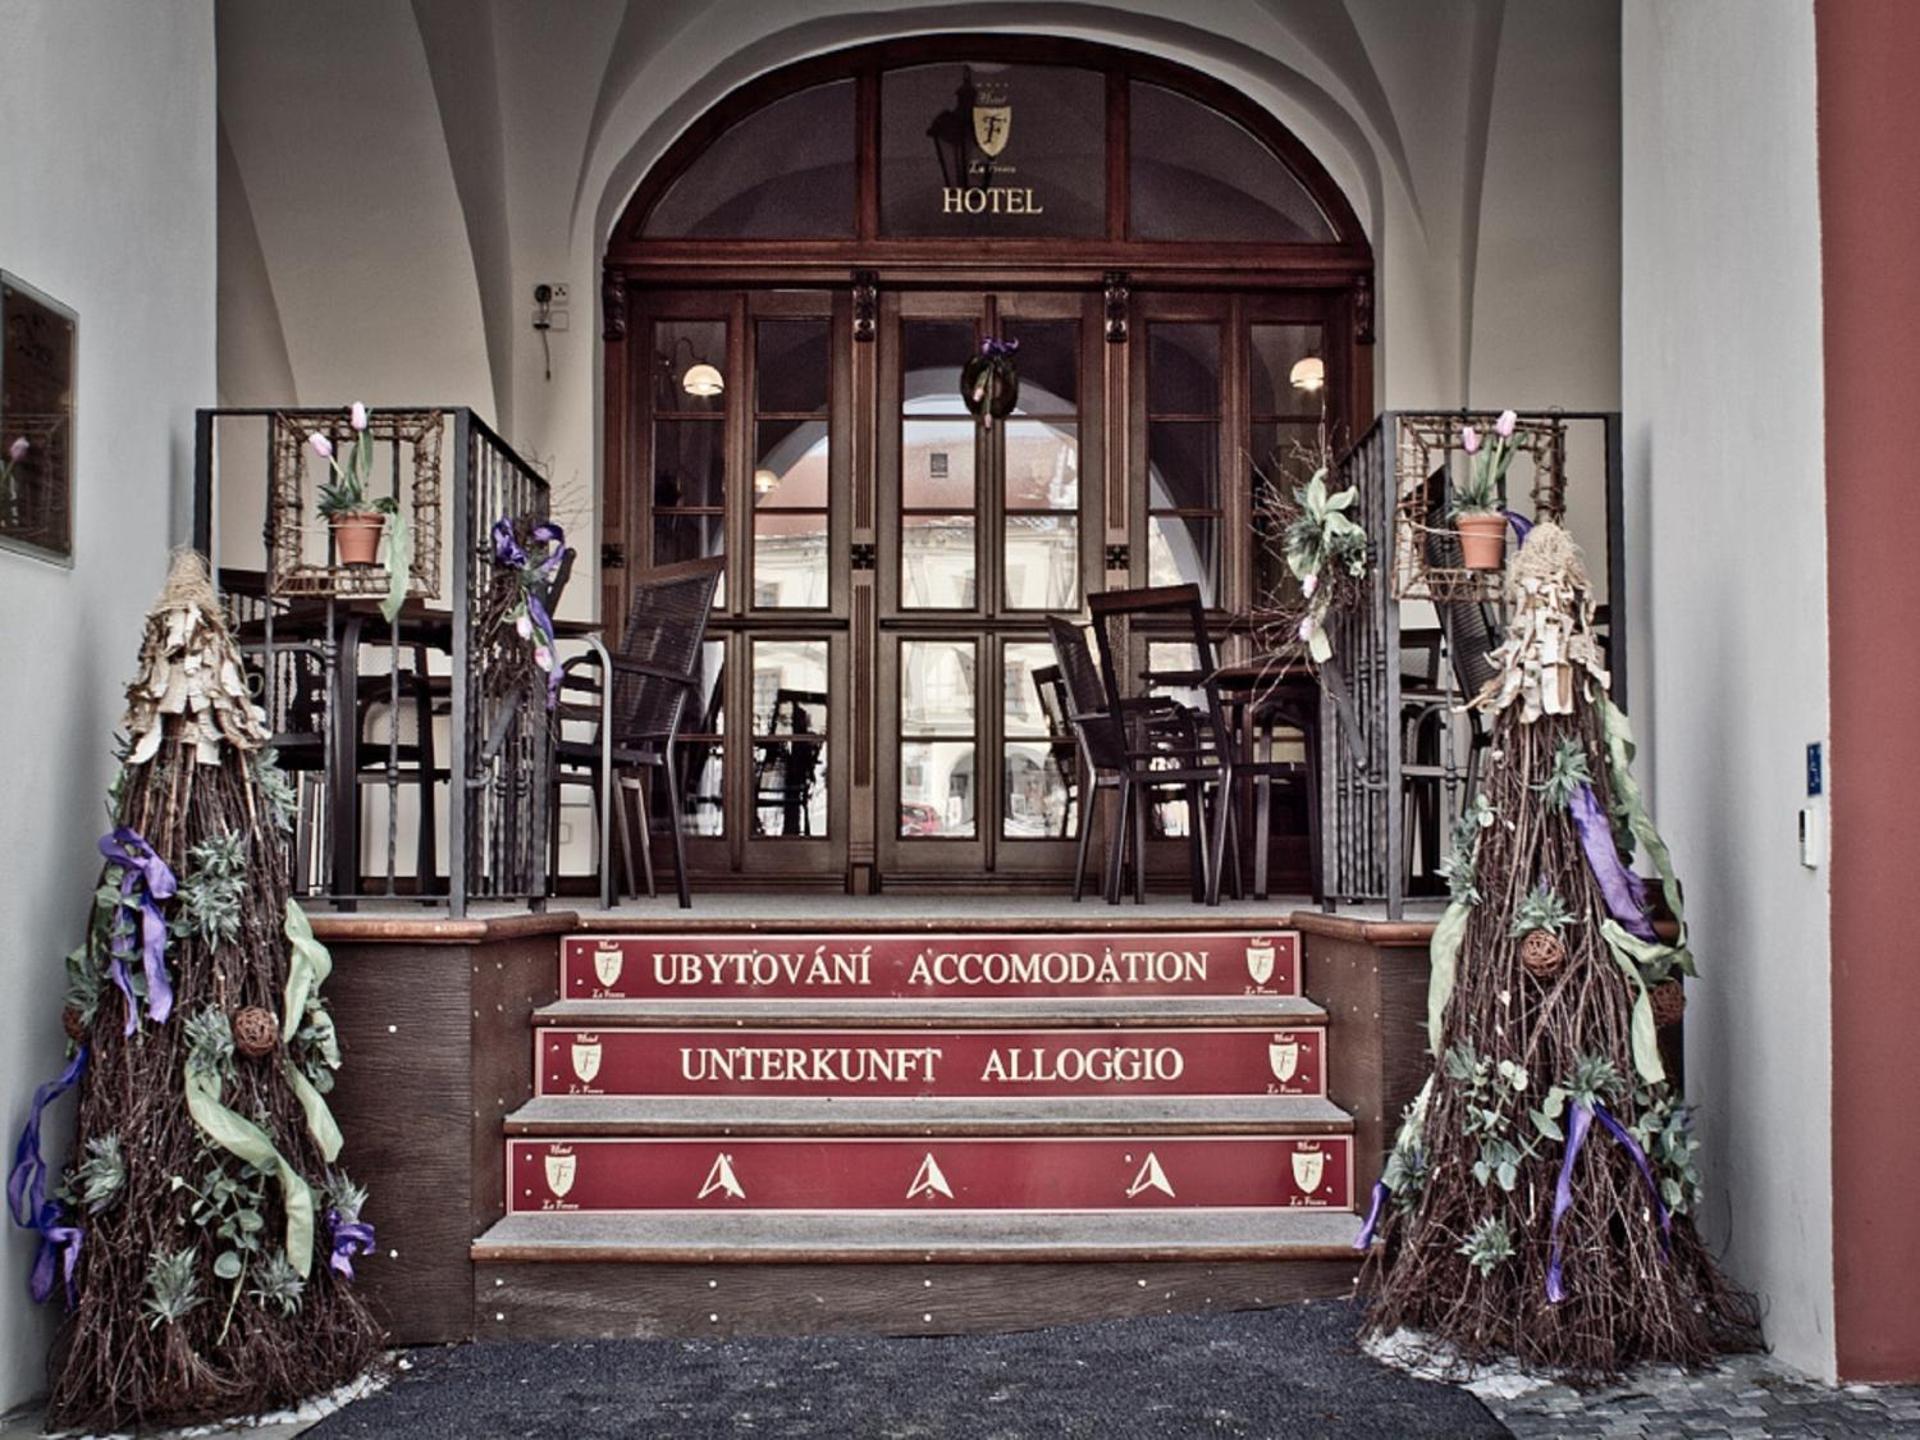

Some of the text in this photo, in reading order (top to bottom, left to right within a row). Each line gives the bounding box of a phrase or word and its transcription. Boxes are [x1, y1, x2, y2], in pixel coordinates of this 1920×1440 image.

[942, 186, 1044, 214] HOTEL
[652, 945, 1209, 985] UBYTOVÁNÍ ACCOMODATION
[679, 1047, 1184, 1082] UNTERKUNFT ALLOGGIO
